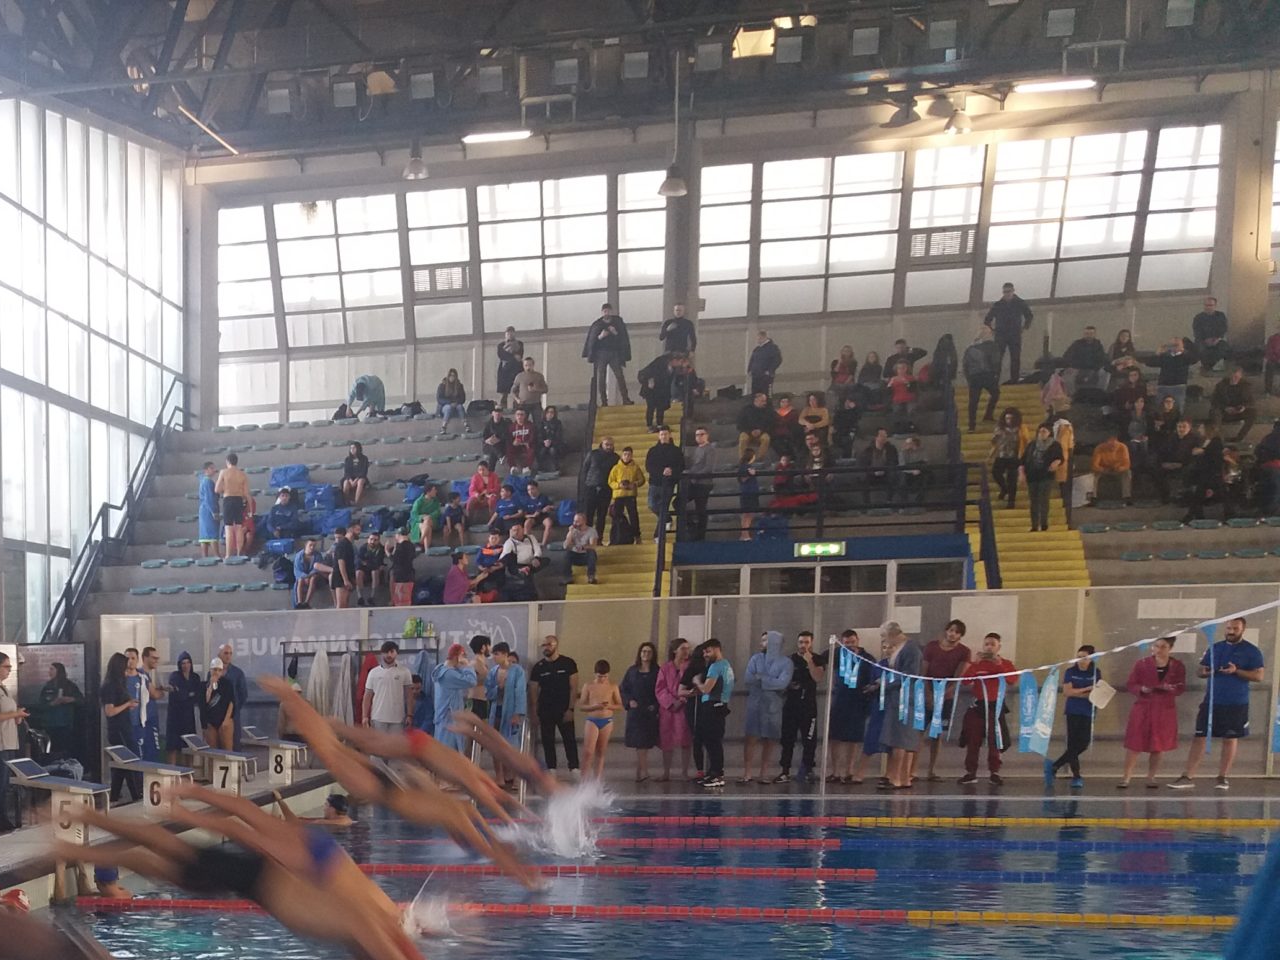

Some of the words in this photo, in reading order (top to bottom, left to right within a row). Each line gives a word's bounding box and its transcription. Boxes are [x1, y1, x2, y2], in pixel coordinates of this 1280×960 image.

[274, 754, 284, 774] 8
[219, 766, 229, 789] 7
[149, 781, 161, 806] 6
[59, 800, 72, 830] 5
